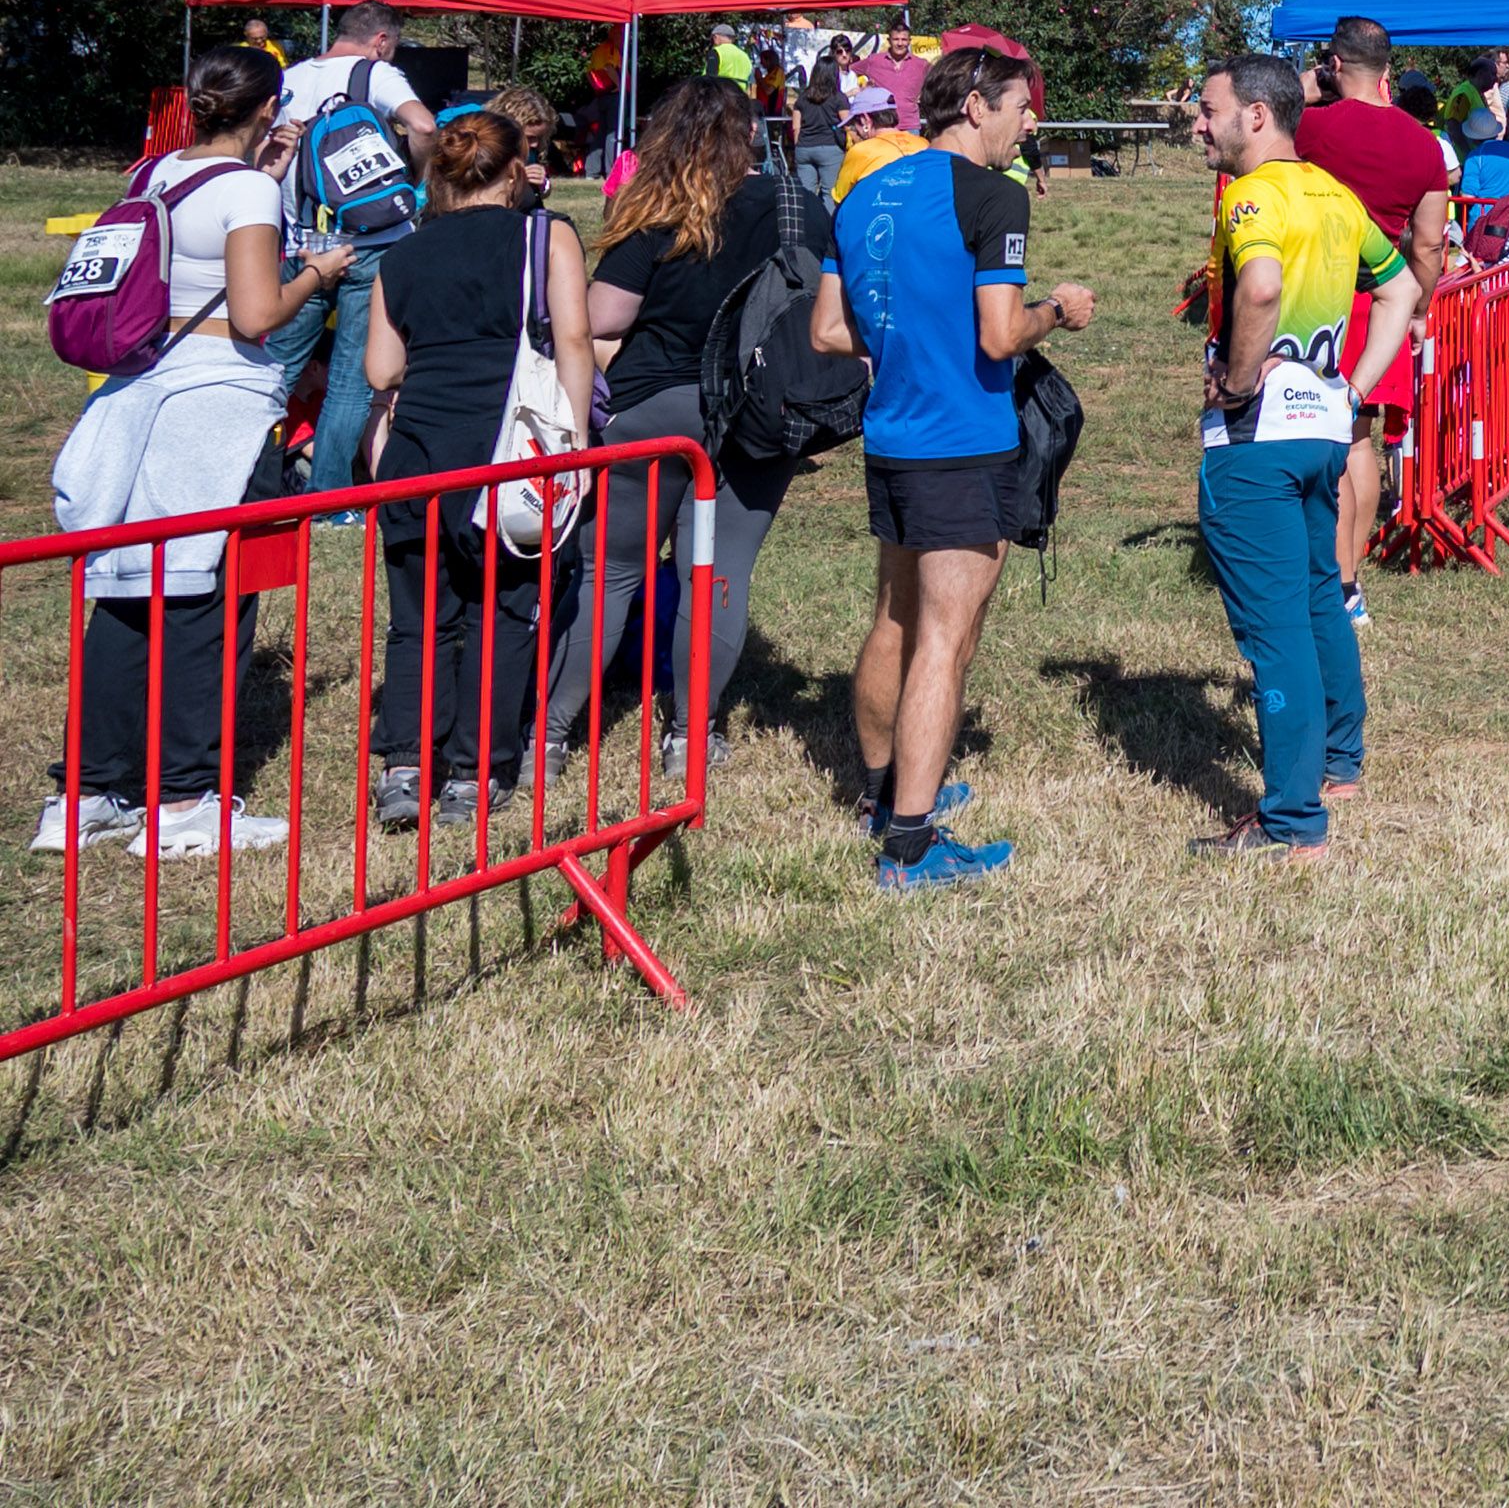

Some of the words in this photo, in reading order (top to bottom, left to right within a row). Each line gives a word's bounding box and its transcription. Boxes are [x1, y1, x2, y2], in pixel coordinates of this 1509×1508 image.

[347, 156, 381, 181] 612
[60, 258, 104, 286] 628
[1286, 412, 1297, 420] de
